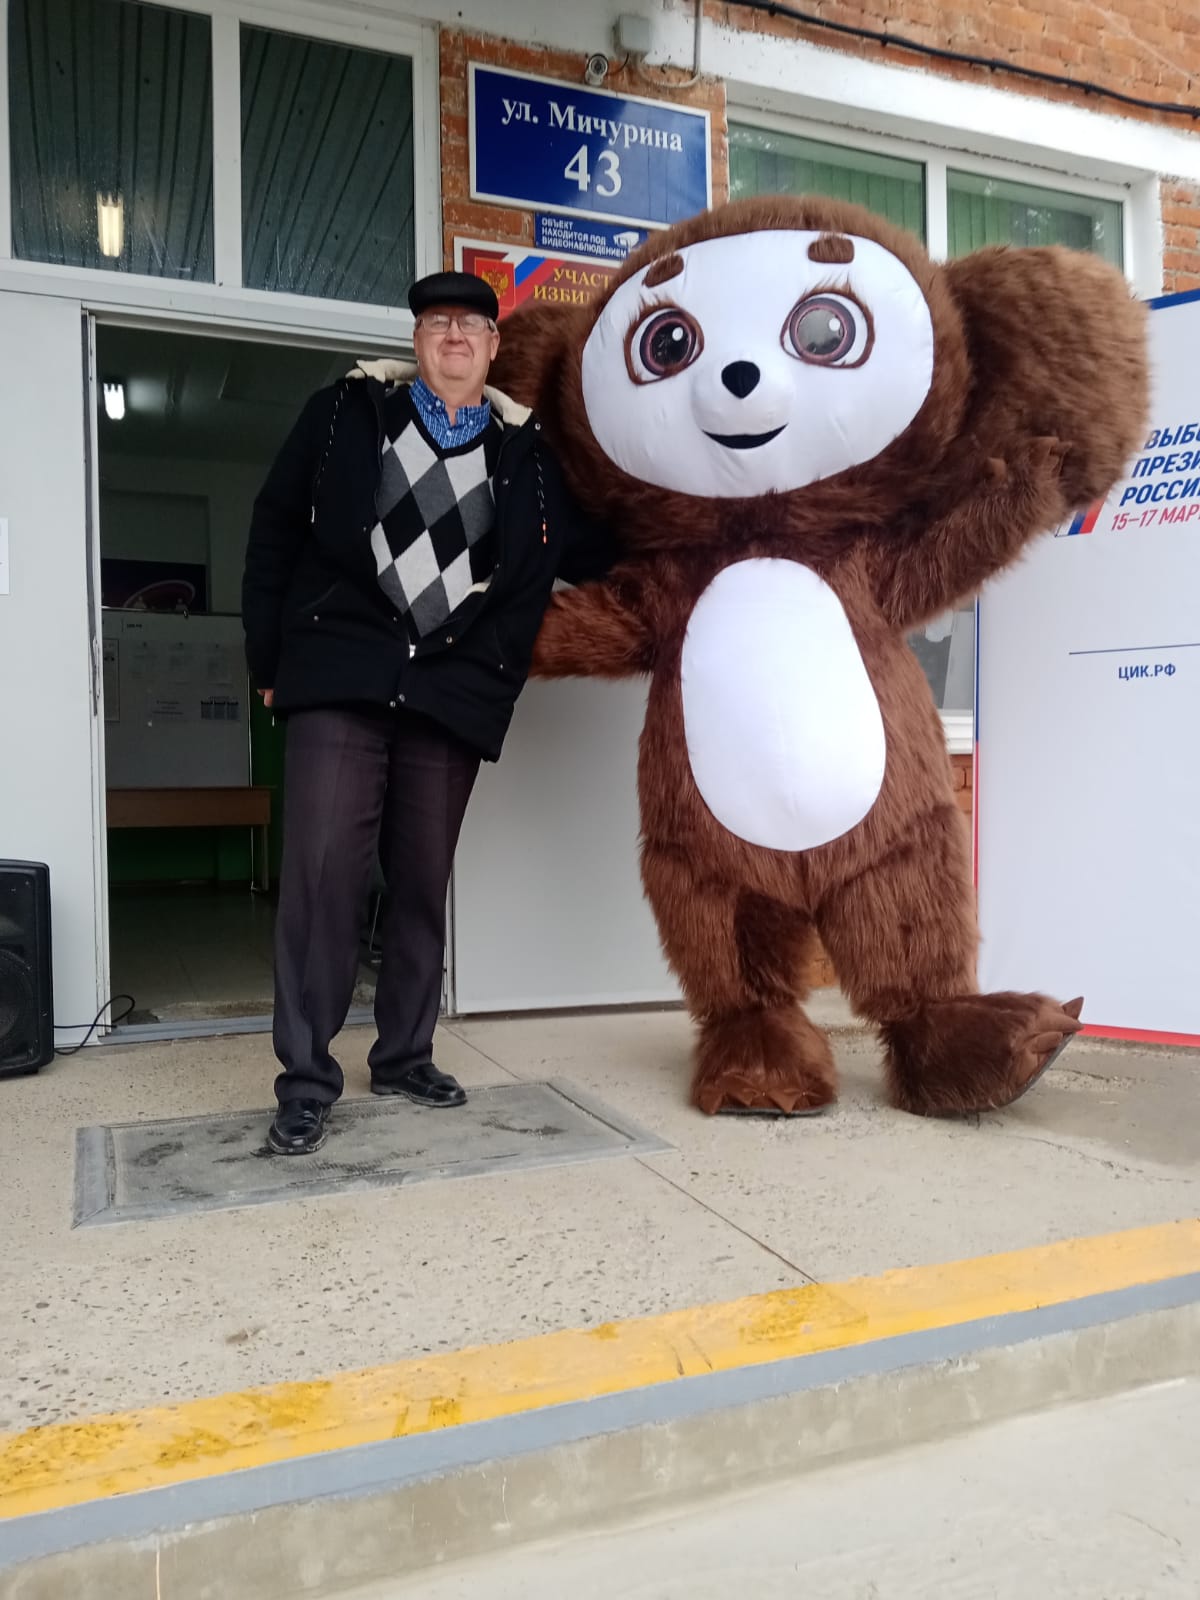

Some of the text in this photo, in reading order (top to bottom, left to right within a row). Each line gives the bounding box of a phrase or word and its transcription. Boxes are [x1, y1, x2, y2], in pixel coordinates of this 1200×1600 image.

[502, 99, 683, 153] ул. Мичурина
[564, 144, 622, 197] 43
[541, 217, 574, 230] ОБЪЕКТ
[541, 227, 606, 245] НАХОДИТСЯ ПОД
[541, 237, 627, 258] ВИДЕОНАБЛЮДЕНИЕМ
[1144, 423, 1200, 450] ВЫБ
[1119, 477, 1200, 507] РОССИ
[1158, 503, 1200, 525] МАР
[1118, 663, 1176, 681] ЦИК.РФ
